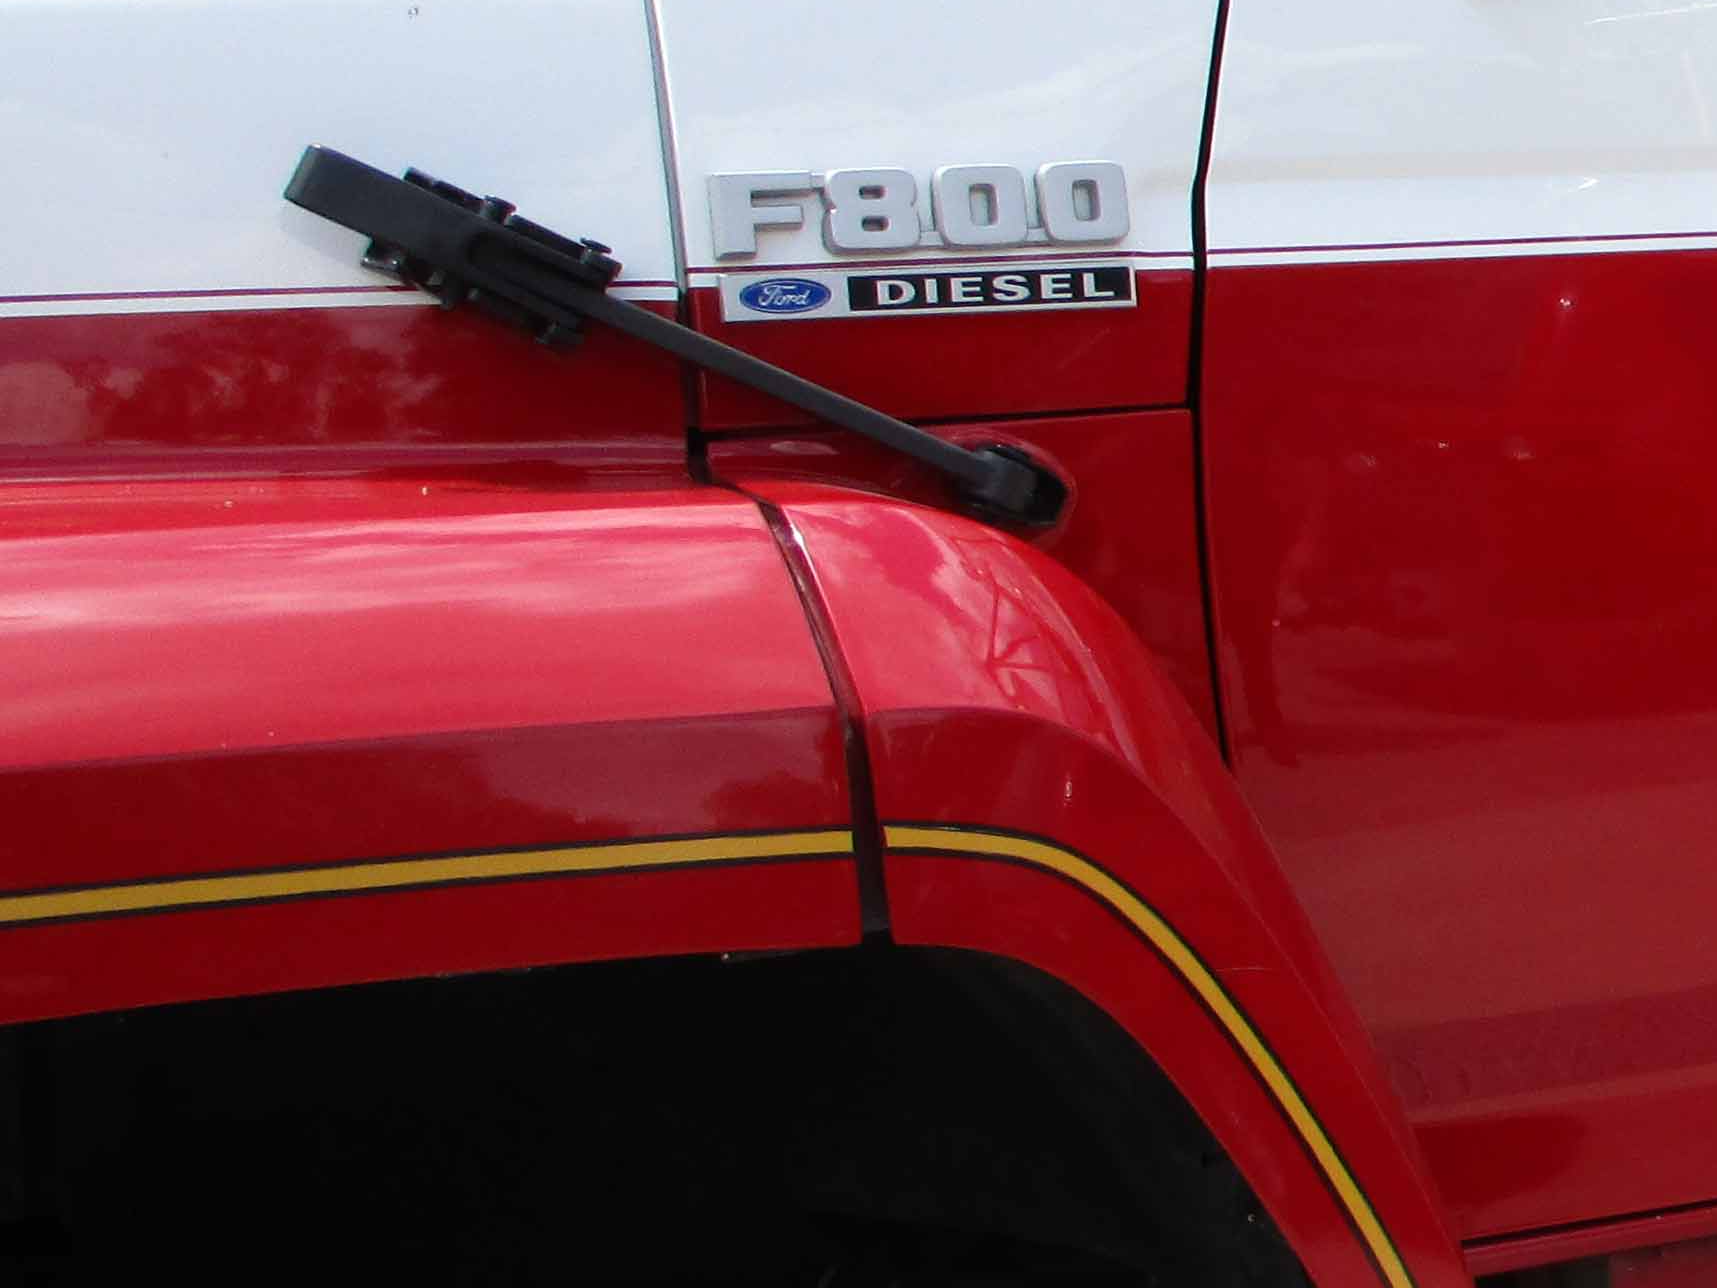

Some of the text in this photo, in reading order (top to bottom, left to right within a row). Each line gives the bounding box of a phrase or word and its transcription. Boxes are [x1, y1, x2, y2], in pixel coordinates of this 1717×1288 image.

[706, 160, 1131, 260] F800
[757, 271, 1116, 309] Ford DIESEL
